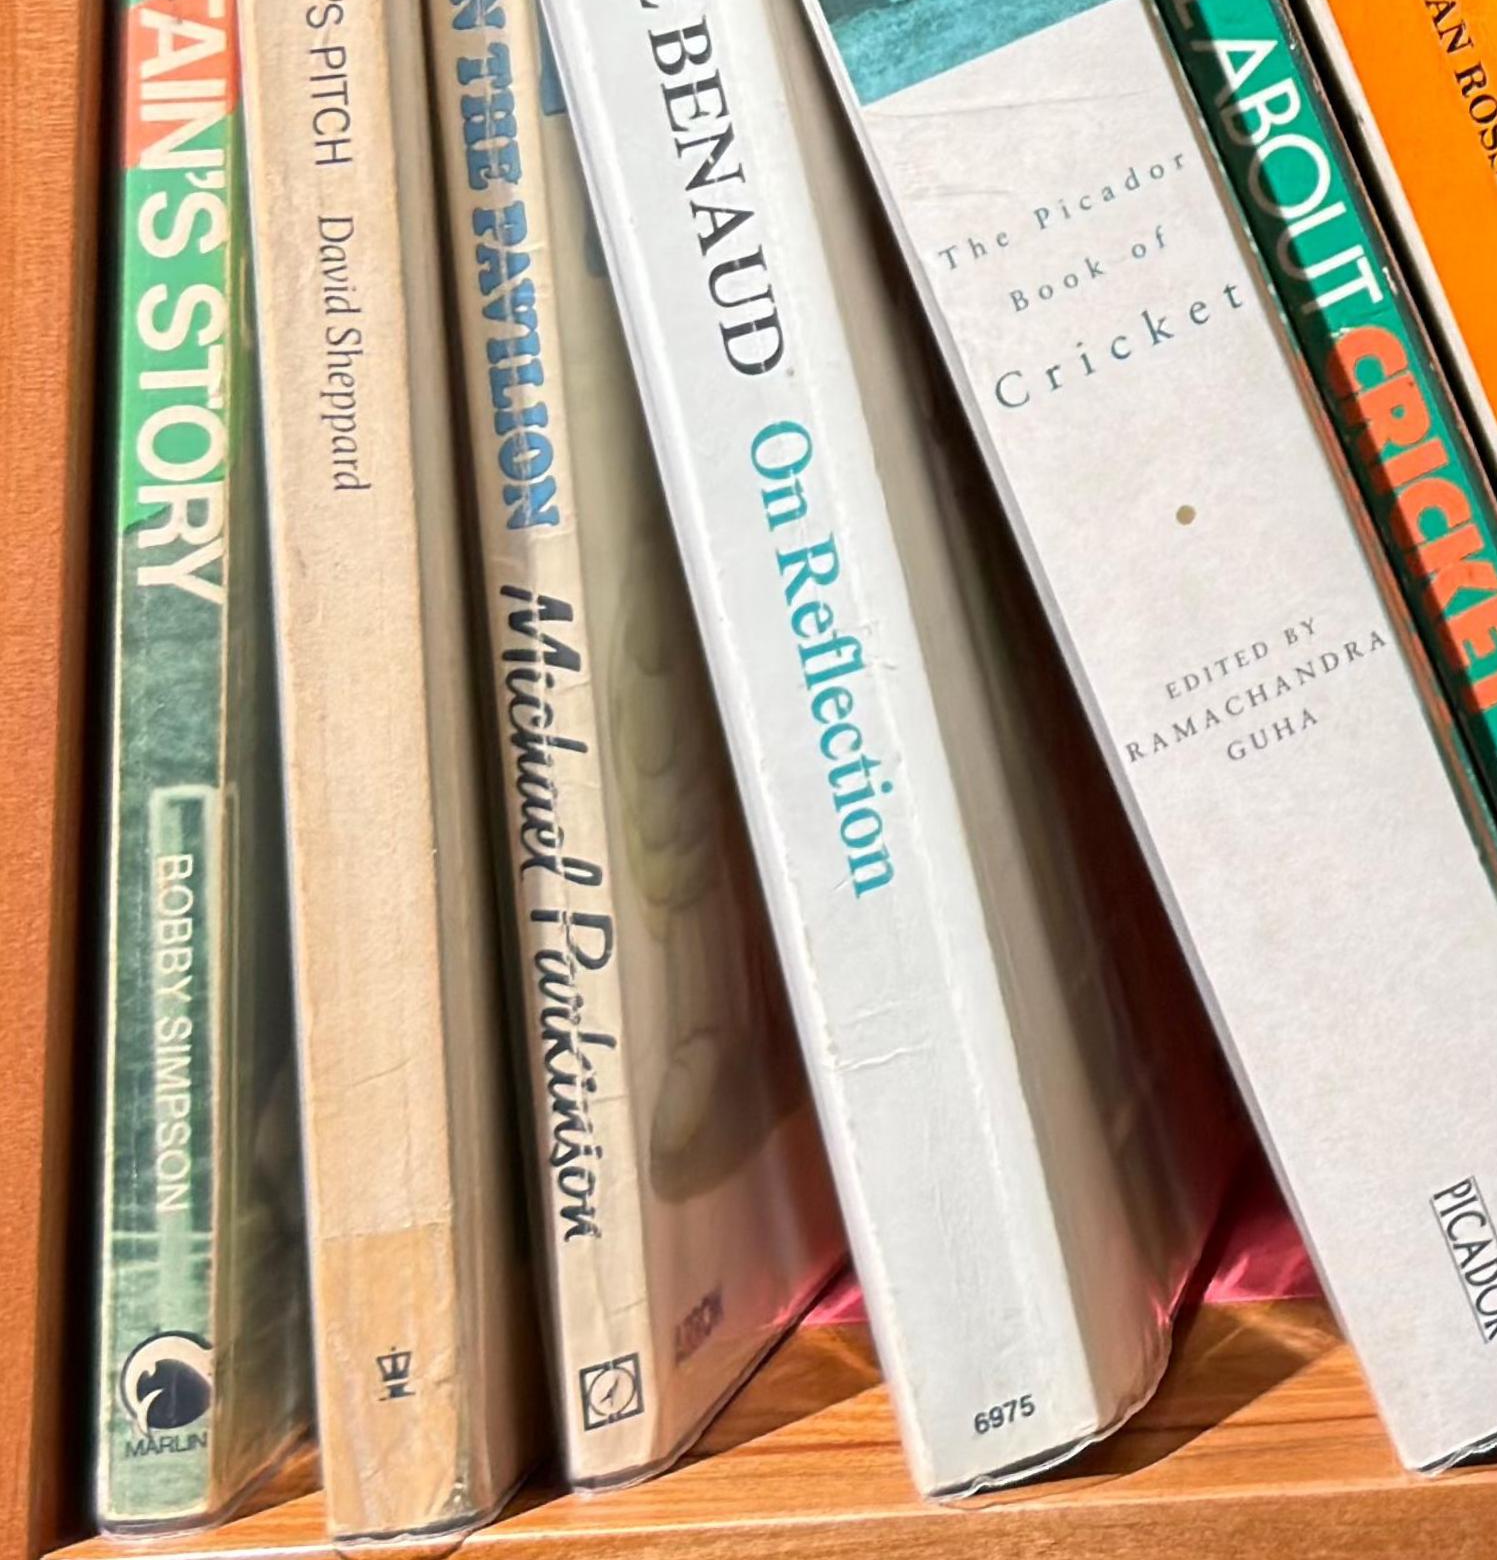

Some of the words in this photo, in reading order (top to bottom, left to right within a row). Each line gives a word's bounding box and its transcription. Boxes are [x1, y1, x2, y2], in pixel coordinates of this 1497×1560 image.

[307, 45, 353, 166] PITCH
[456, 41, 522, 192] THE
[1195, 36, 1384, 314] ABOUT
[317, 215, 355, 315] David
[647, 13, 786, 377] BENAUD
[938, 229, 1011, 272] The
[1034, 151, 1188, 232] Picador
[1009, 258, 1108, 313] Book
[1131, 225, 1170, 261] of
[319, 327, 372, 493] Sheppard
[472, 204, 561, 531] PAVILION
[993, 281, 1246, 411] Cricket
[136, 283, 227, 606] STORY
[748, 418, 813, 533] On
[776, 532, 897, 900] Reflection
[1125, 629, 1391, 764] RAMACHANDRA
[1165, 640, 1272, 703] EDITED
[1284, 617, 1319, 647] BY
[501, 585, 603, 887] Michael
[1226, 707, 1321, 764] GUHA
[155, 852, 194, 1009] BOBBY
[155, 1018, 194, 1214] SIMPSON
[530, 909, 616, 1243] Parkinson
[125, 1432, 209, 1459] MARLIN
[973, 1393, 1035, 1435] 6975
